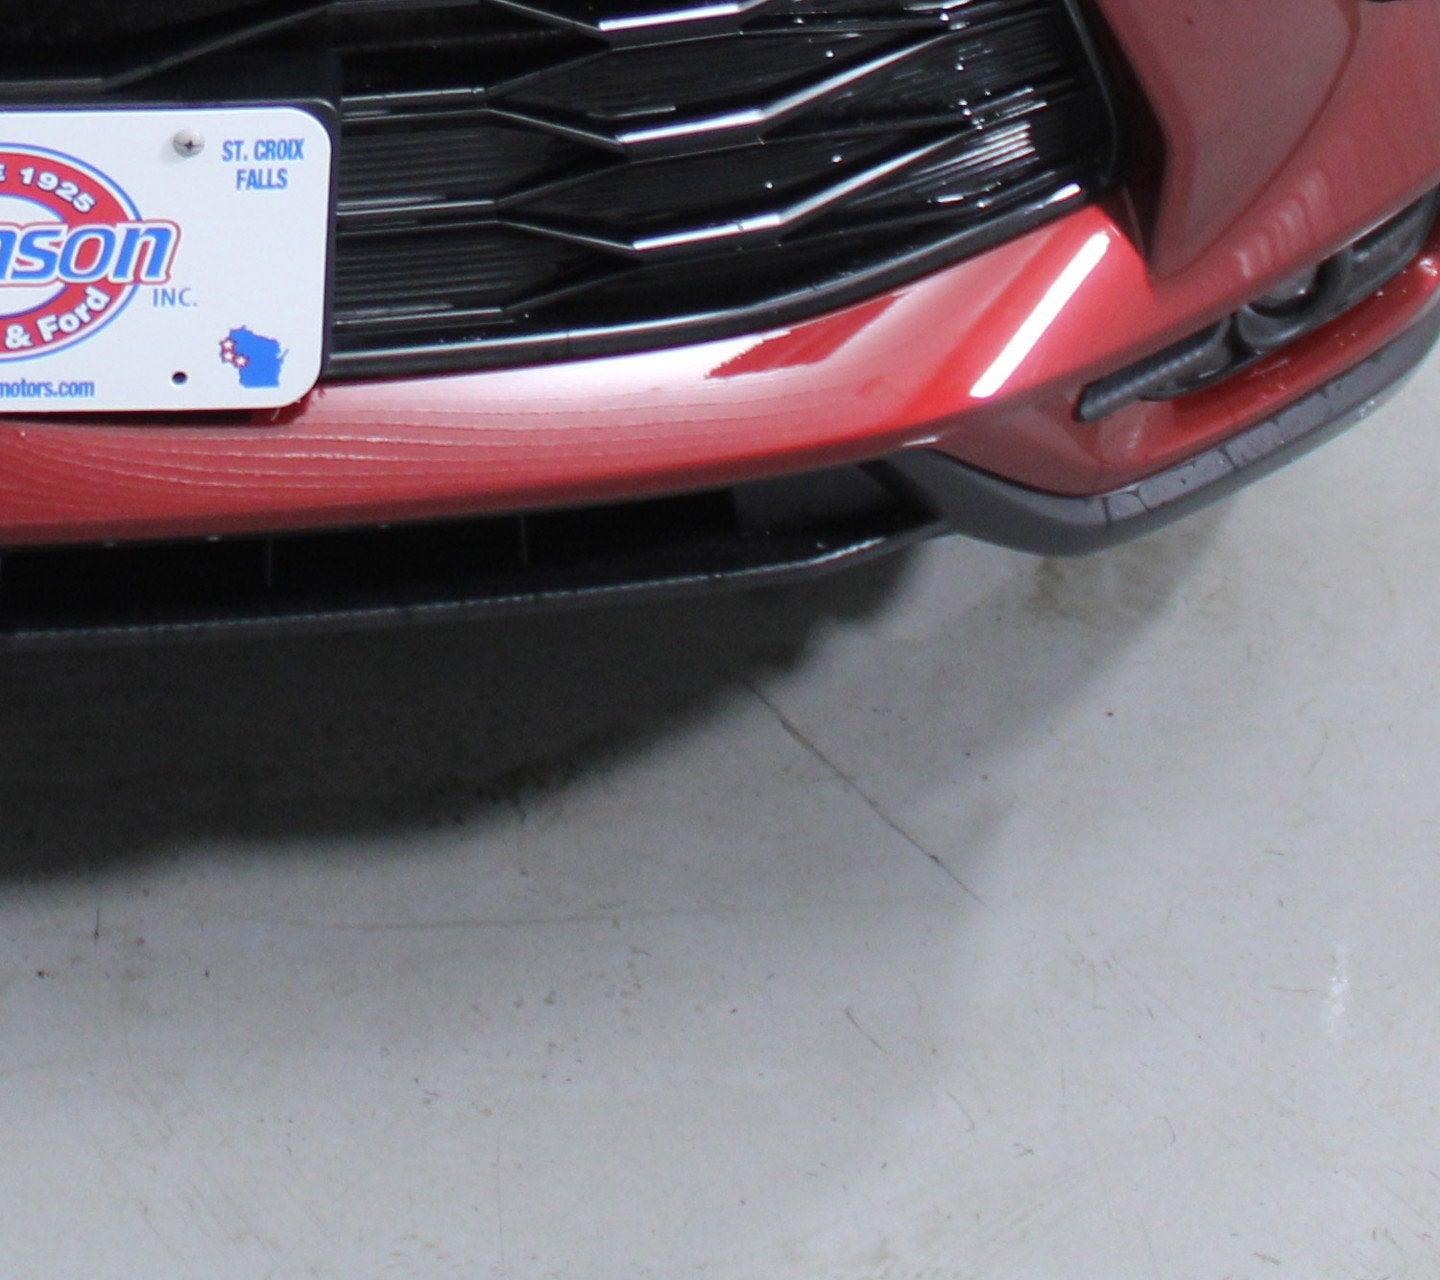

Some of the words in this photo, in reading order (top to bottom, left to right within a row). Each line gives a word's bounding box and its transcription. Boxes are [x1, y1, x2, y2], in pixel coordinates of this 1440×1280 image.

[222, 139, 248, 161] ST.
[254, 138, 305, 160] CROIX
[19, 166, 97, 214] 1925
[236, 168, 288, 190] FALLS
[152, 287, 198, 308] INC.
[5, 323, 34, 350] &
[36, 285, 111, 342] Ford
